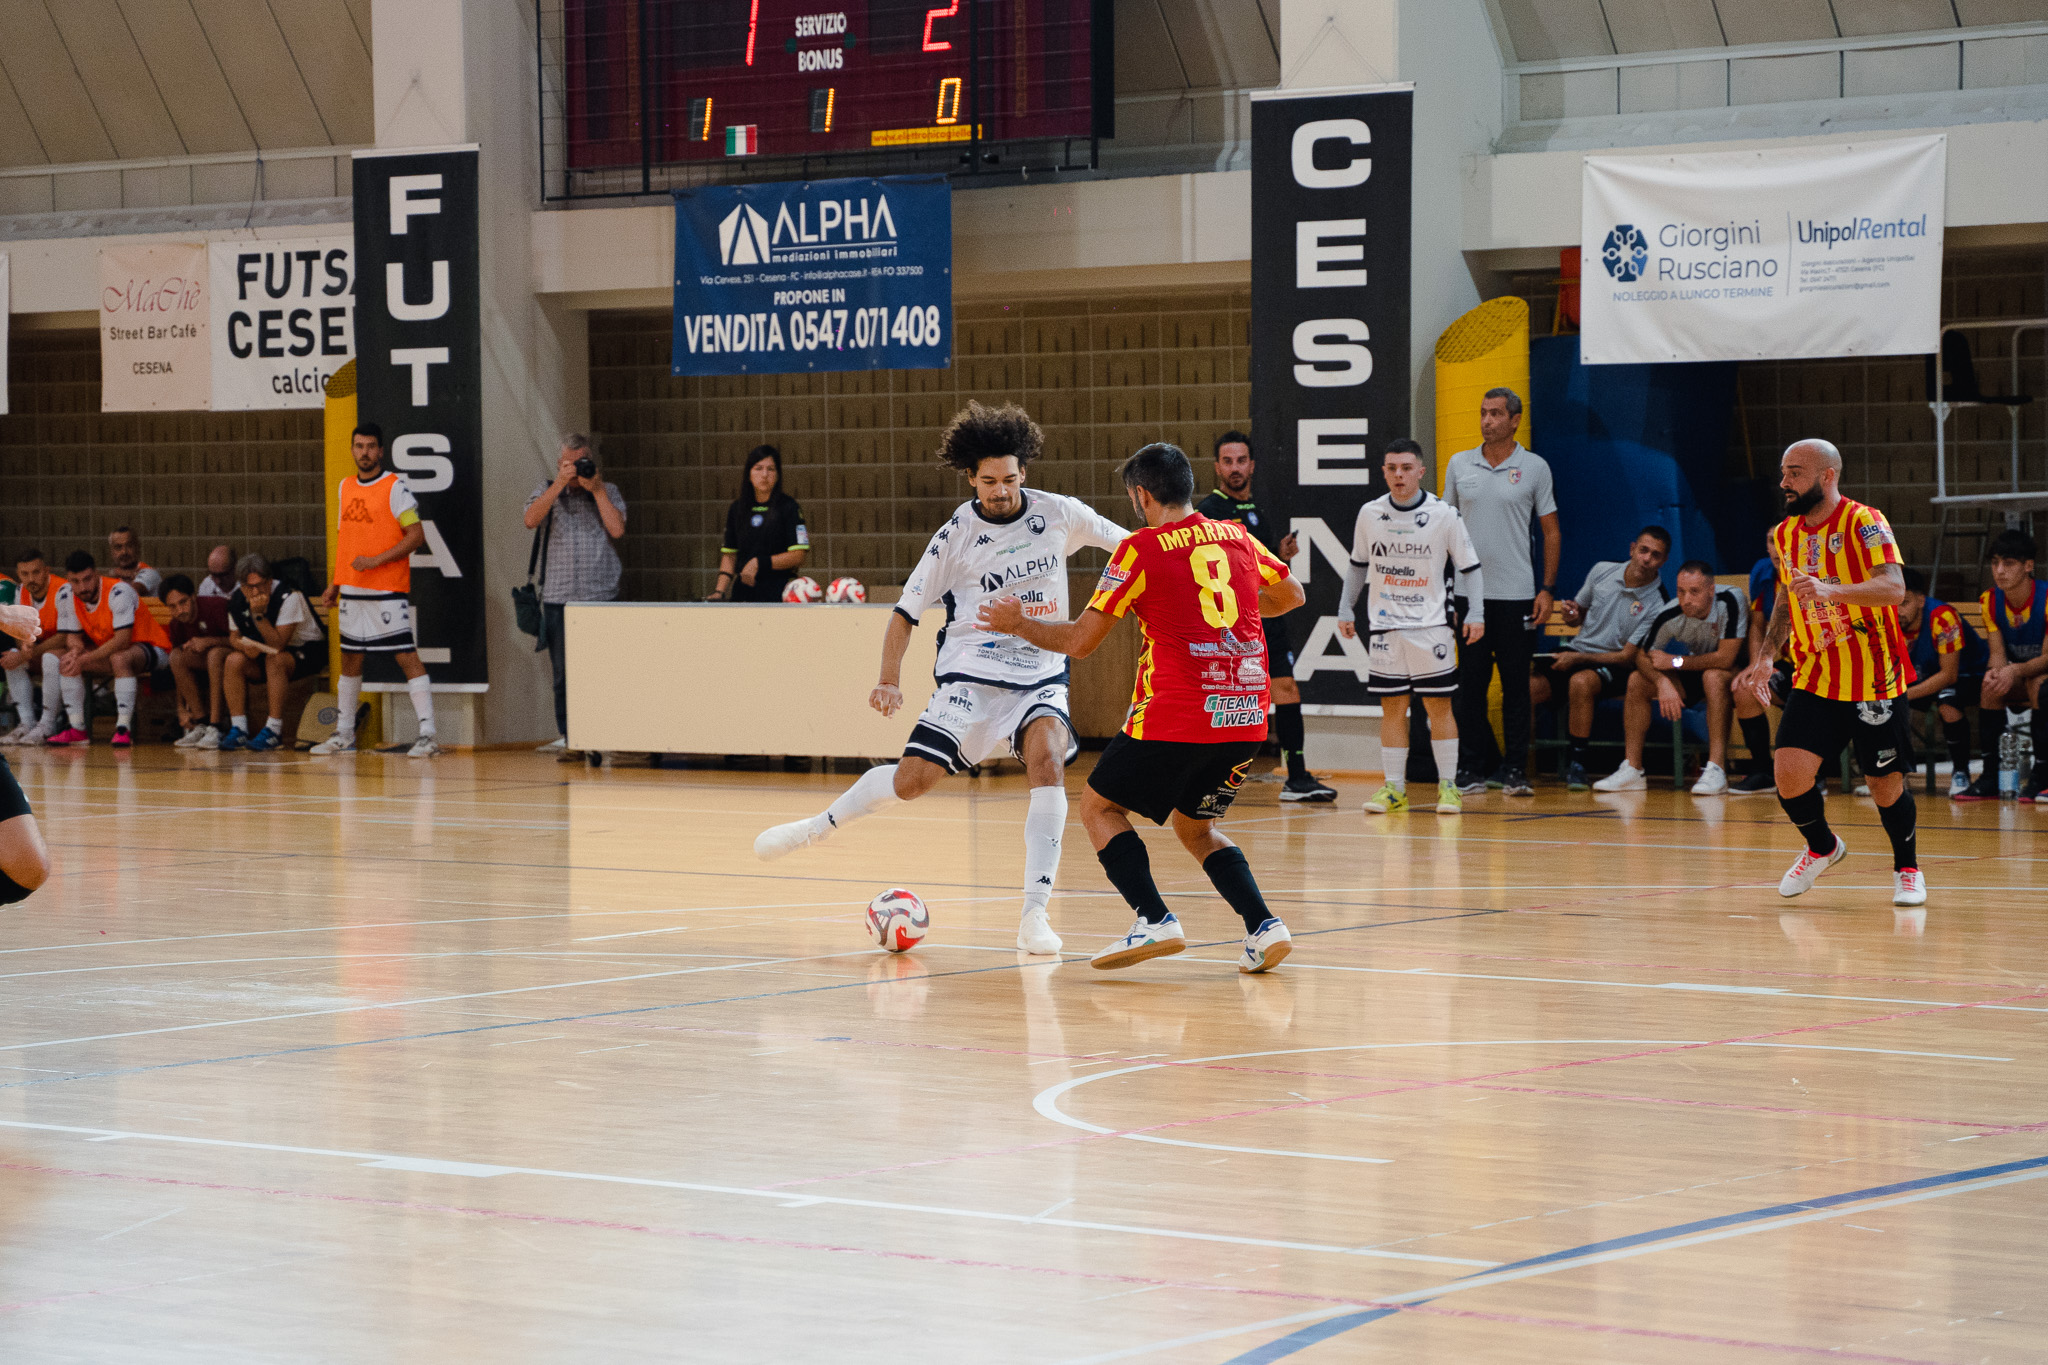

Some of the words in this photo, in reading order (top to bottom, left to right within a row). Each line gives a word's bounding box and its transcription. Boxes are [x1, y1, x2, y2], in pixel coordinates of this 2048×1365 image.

[795, 12, 847, 37] SERVIZIO
[798, 48, 843, 72] BONUS
[824, 88, 835, 132] 1
[936, 77, 962, 125] 0
[702, 97, 712, 141] 1
[771, 194, 897, 245] ALPHA
[1798, 213, 1926, 250] UnipolRental
[1659, 220, 1762, 251] Giorgini
[772, 250, 830, 263] mediazioni
[834, 246, 898, 260] immobiliari
[237, 248, 356, 301] FUTS
[700, 276, 714, 285] Via
[760, 273, 786, 283] Cesena
[1658, 255, 1778, 282] Rusciano
[774, 289, 830, 306] PROPONE
[832, 288, 846, 302] IN
[1612, 290, 1668, 302] NOLEGGIO
[1670, 290, 1679, 300] A
[1680, 288, 1720, 300] LUNGO
[1723, 286, 1774, 298] TERMINE
[110, 326, 144, 340] Street
[148, 326, 168, 339] Bar
[227, 306, 355, 360] CESE
[684, 312, 786, 354] VENDITA
[790, 304, 941, 350] 0547.071408
[132, 362, 174, 374] CESENA
[1290, 118, 1374, 683] CESENA
[1156, 522, 1244, 552] IMPARATO
[1388, 543, 1432, 555] ALPHA
[1006, 554, 1058, 580] ALPHA
[1189, 544, 1240, 628] 8
[1384, 574, 1429, 588] Ricambi
[1220, 695, 1258, 710] TEAM
[1225, 710, 1264, 726] WEAR
